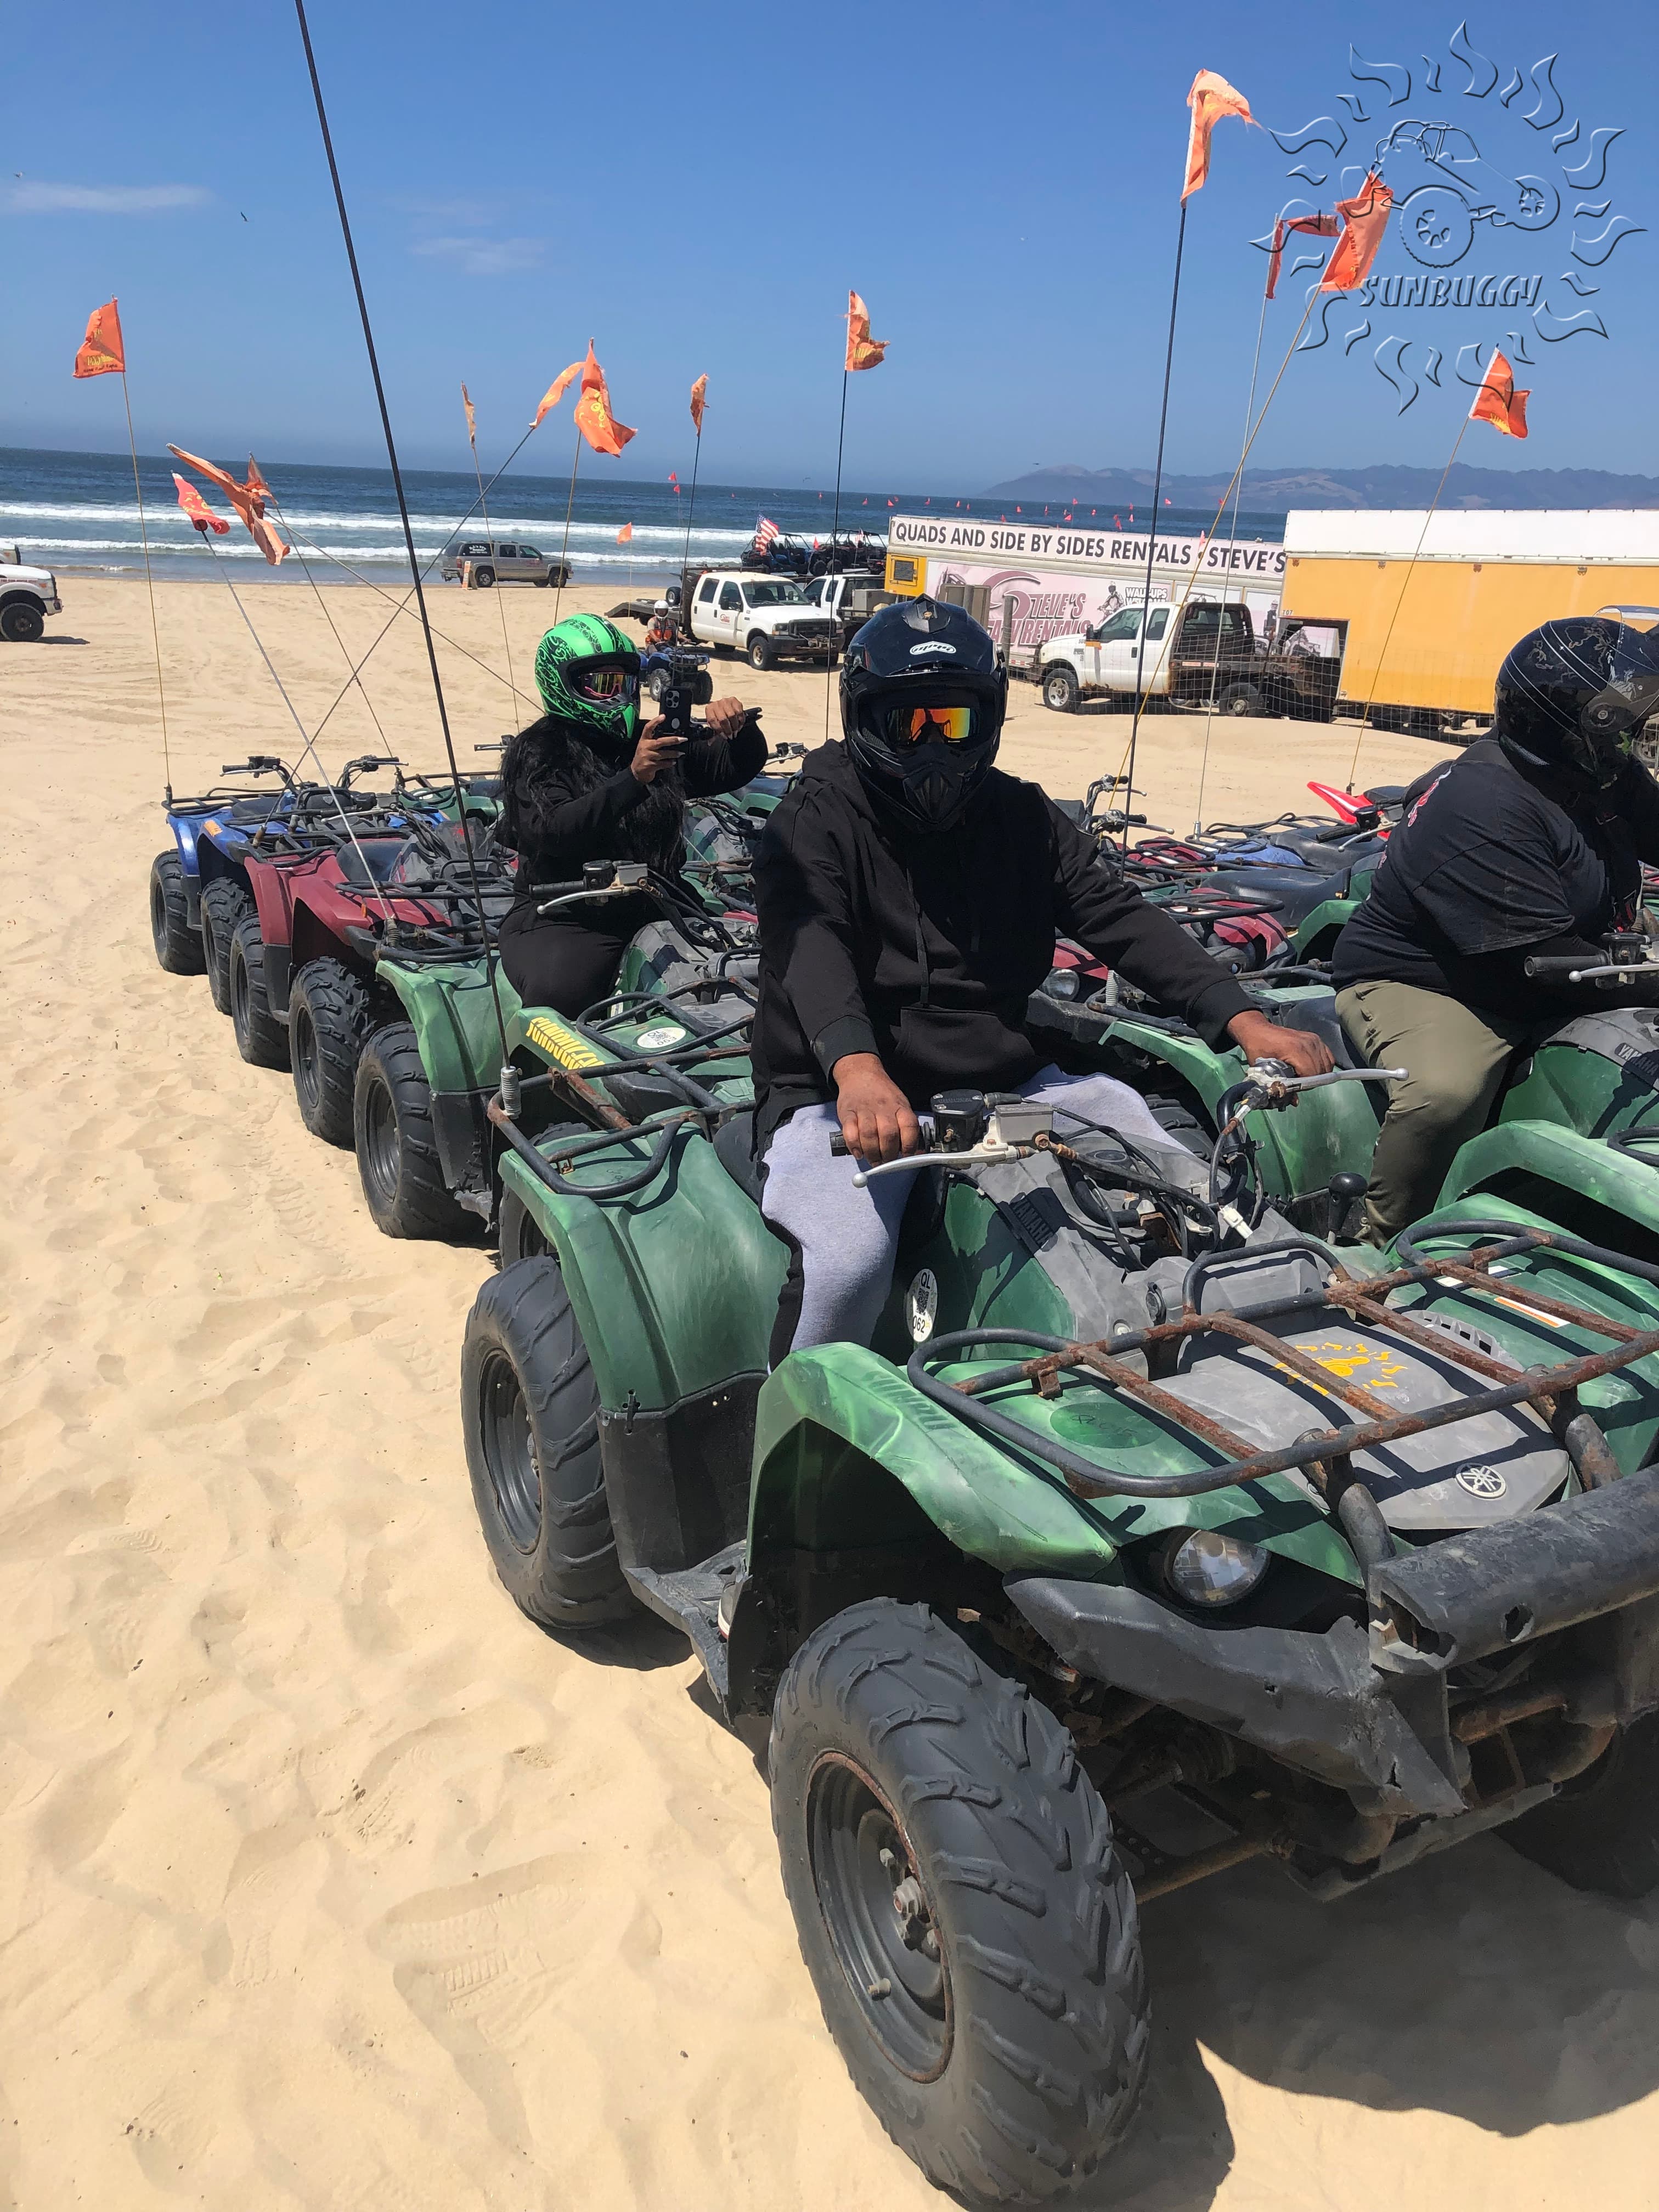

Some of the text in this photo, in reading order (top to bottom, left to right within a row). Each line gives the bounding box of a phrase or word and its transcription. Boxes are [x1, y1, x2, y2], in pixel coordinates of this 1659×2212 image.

[896, 523, 946, 544] QUADS
[951, 528, 986, 547] AND
[990, 531, 1026, 551] SIDE
[1031, 534, 1053, 552] BY
[1056, 536, 1104, 558] SIDES
[1207, 546, 1286, 573] STEVE'S
[1012, 1198, 1053, 1245] YAMAHA
[921, 1272, 930, 1289] QL
[912, 1315, 926, 1334] 062
